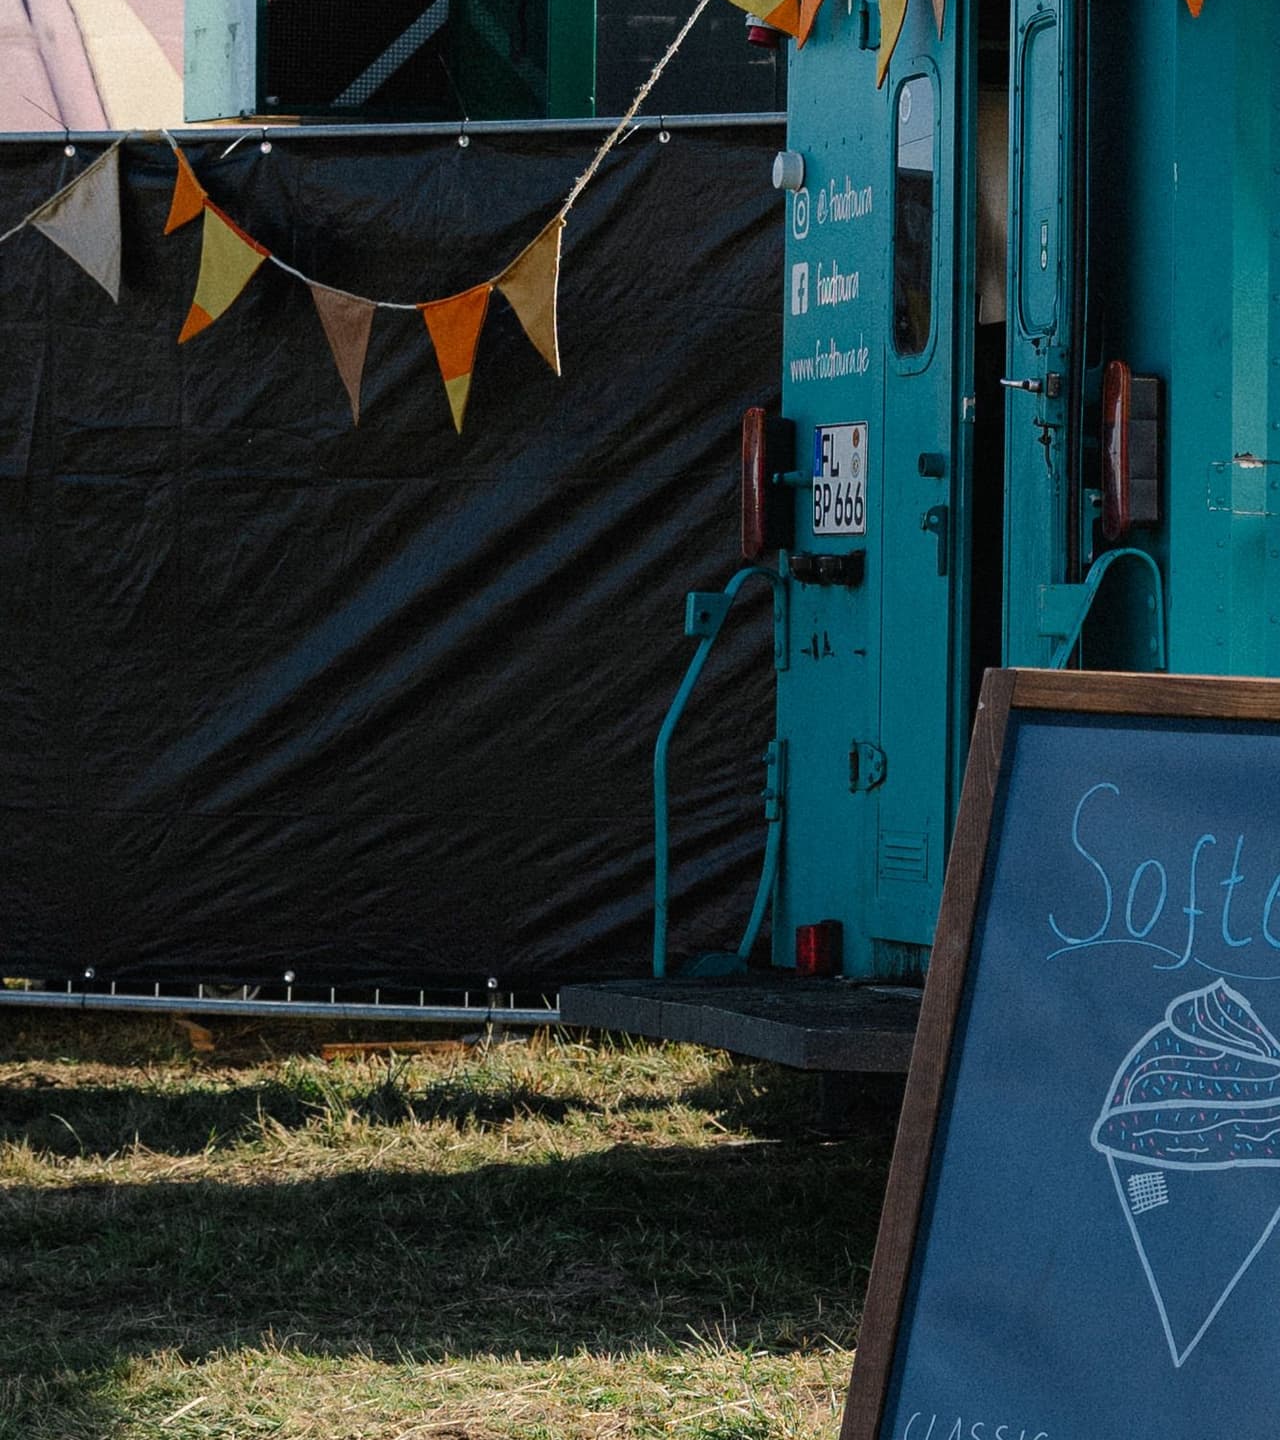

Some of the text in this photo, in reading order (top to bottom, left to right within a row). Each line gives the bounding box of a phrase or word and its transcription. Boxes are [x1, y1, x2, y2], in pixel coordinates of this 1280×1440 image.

[822, 433, 840, 478] FL
[813, 481, 864, 528] BP 666
